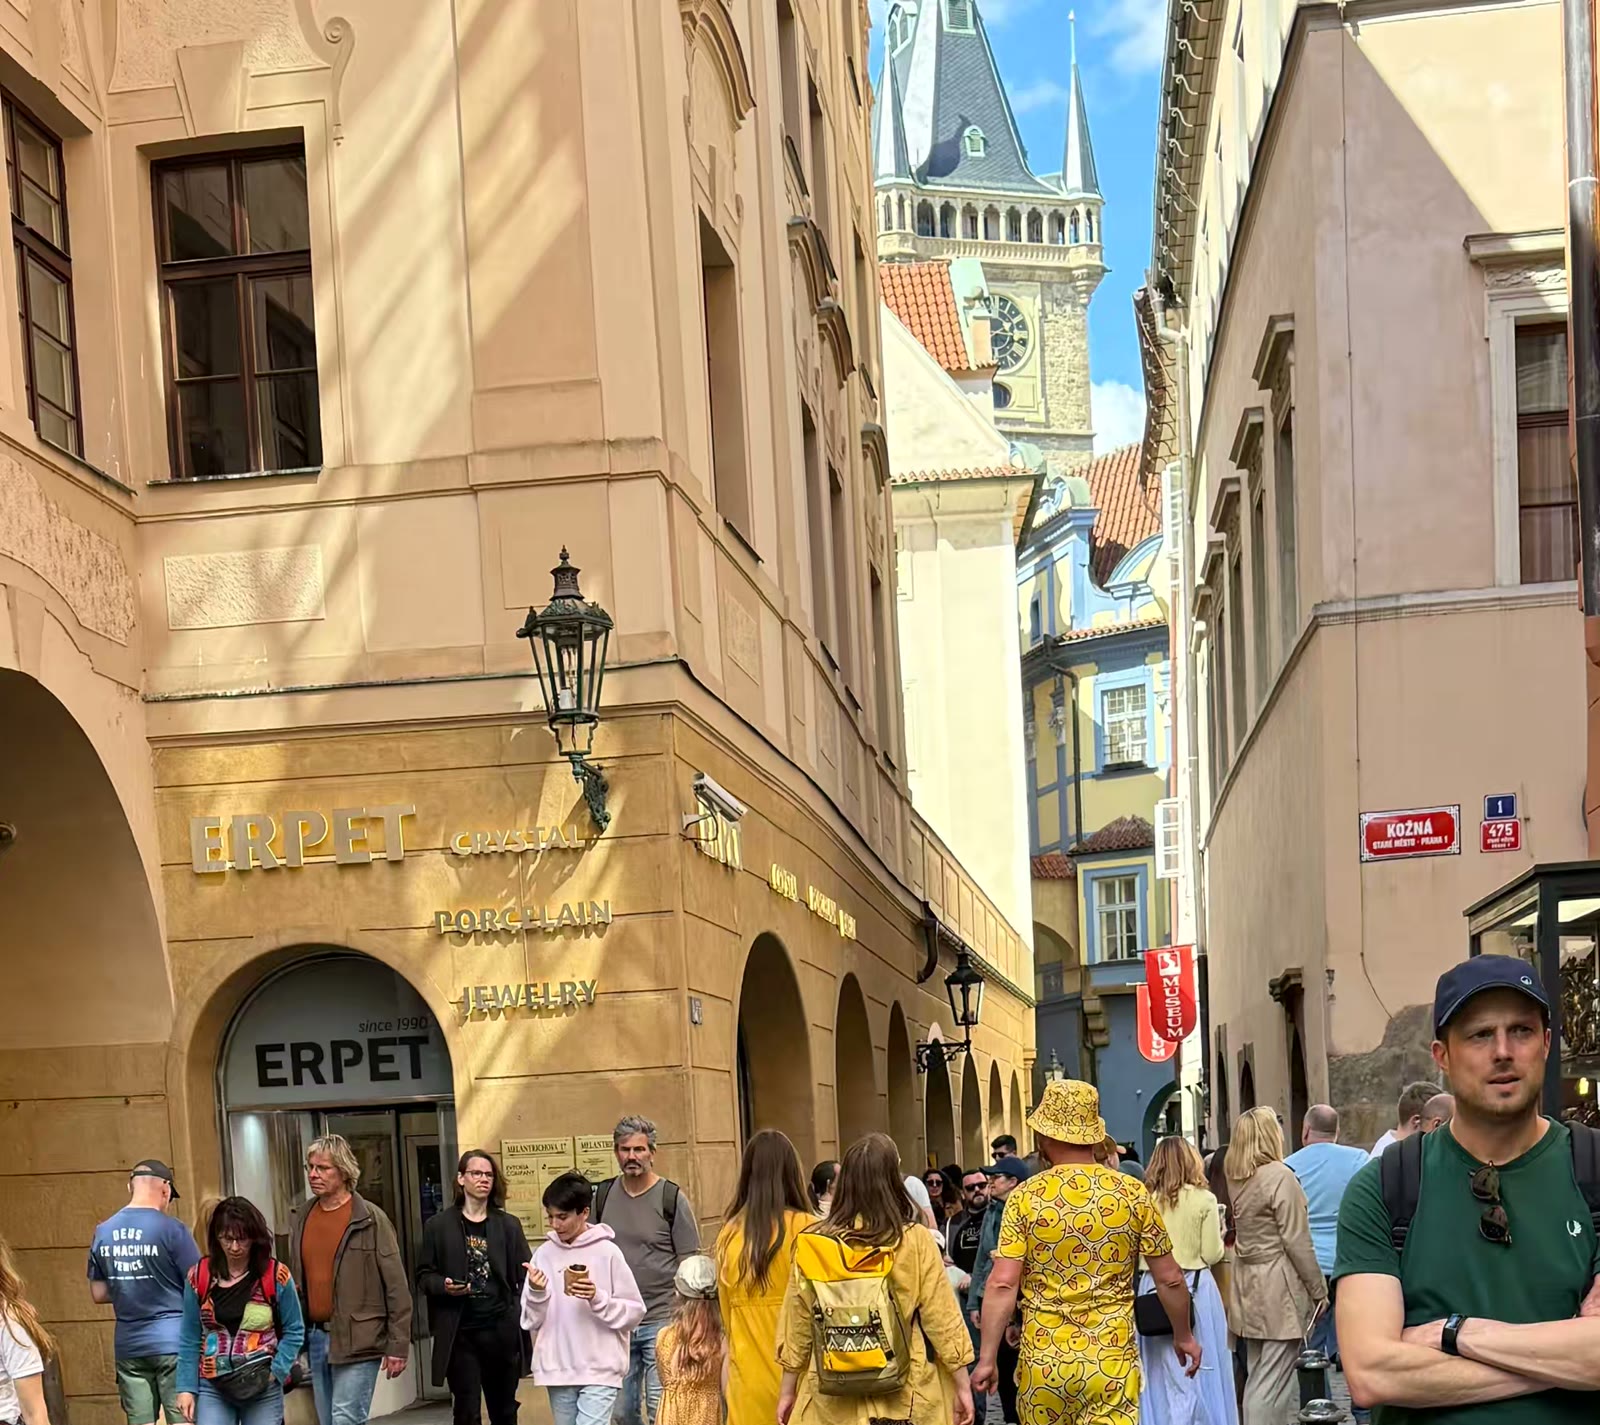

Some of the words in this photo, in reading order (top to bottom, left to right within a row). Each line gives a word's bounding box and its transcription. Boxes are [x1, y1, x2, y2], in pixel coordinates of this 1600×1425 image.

[1497, 800, 1503, 814] 1
[189, 804, 416, 874] ERPET
[450, 824, 586, 856] CRYSTAL
[1386, 818, 1433, 838] KOŽNÁ
[1488, 823, 1513, 837] 475
[434, 899, 613, 935] PORCELAIN
[462, 979, 598, 1017] JEWELRY
[1162, 975, 1184, 1038] MUSEUM
[358, 1020, 393, 1033] since
[396, 1016, 428, 1031] 1990
[255, 1036, 430, 1088] ERPET
[112, 1228, 143, 1241] DEUS
[100, 1245, 110, 1257] EX
[112, 1244, 159, 1257] MACHINA
